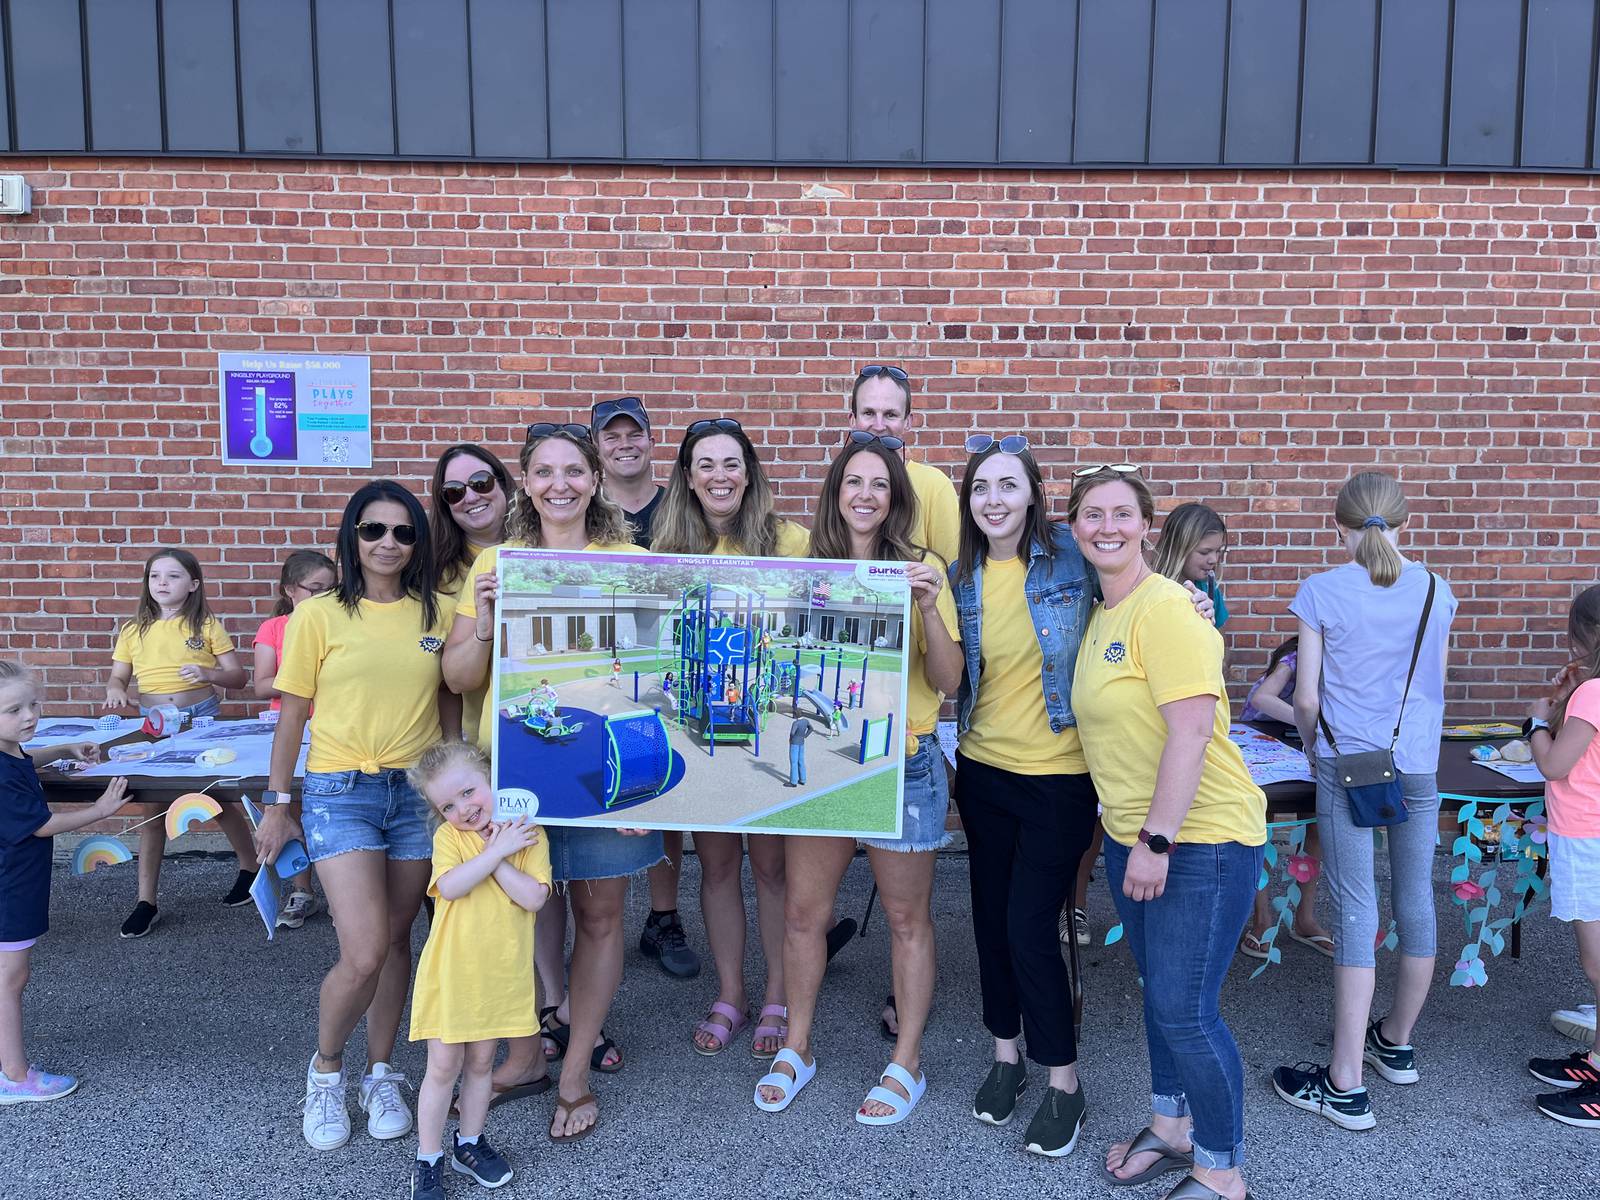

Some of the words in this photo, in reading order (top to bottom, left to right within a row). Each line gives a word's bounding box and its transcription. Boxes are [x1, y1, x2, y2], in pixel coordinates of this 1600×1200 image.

[242, 360, 263, 370] Help
[265, 360, 277, 369] Us
[312, 387, 353, 400] PLAYS
[677, 557, 710, 565] KINGSLEY
[869, 566, 904, 574] Burke
[499, 797, 530, 808] PLAY
